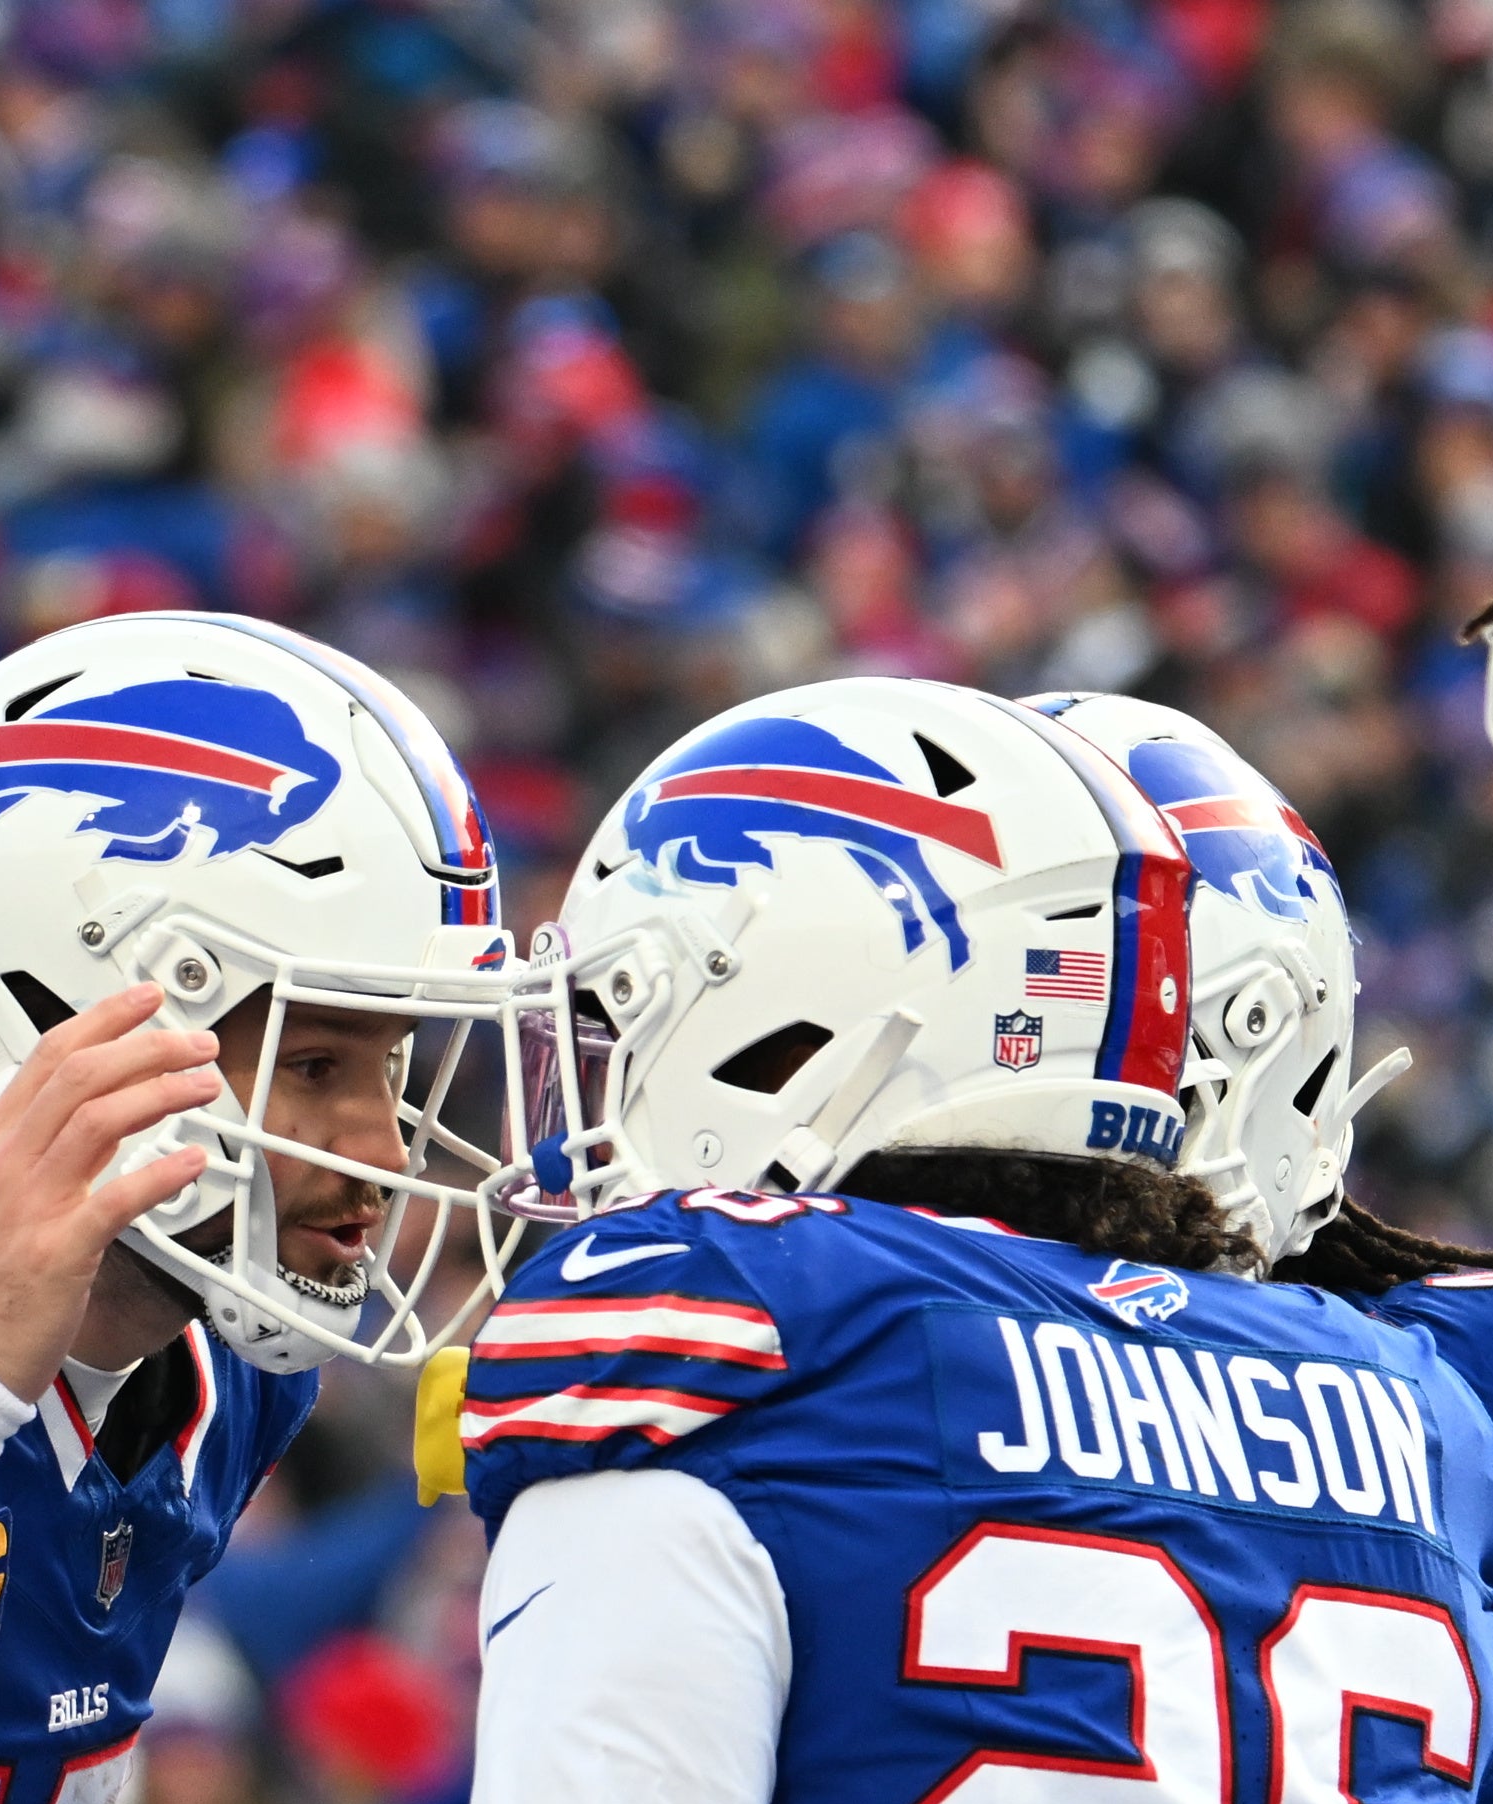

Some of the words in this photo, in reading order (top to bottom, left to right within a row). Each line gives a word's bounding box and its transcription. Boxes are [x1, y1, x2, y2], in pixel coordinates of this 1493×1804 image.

[529, 951, 563, 971] AKLEY
[998, 1035, 1039, 1067] NFL
[1086, 1099, 1187, 1171] BILL
[977, 1316, 1437, 1536] JOHNSON
[48, 1682, 110, 1733] BILLS
